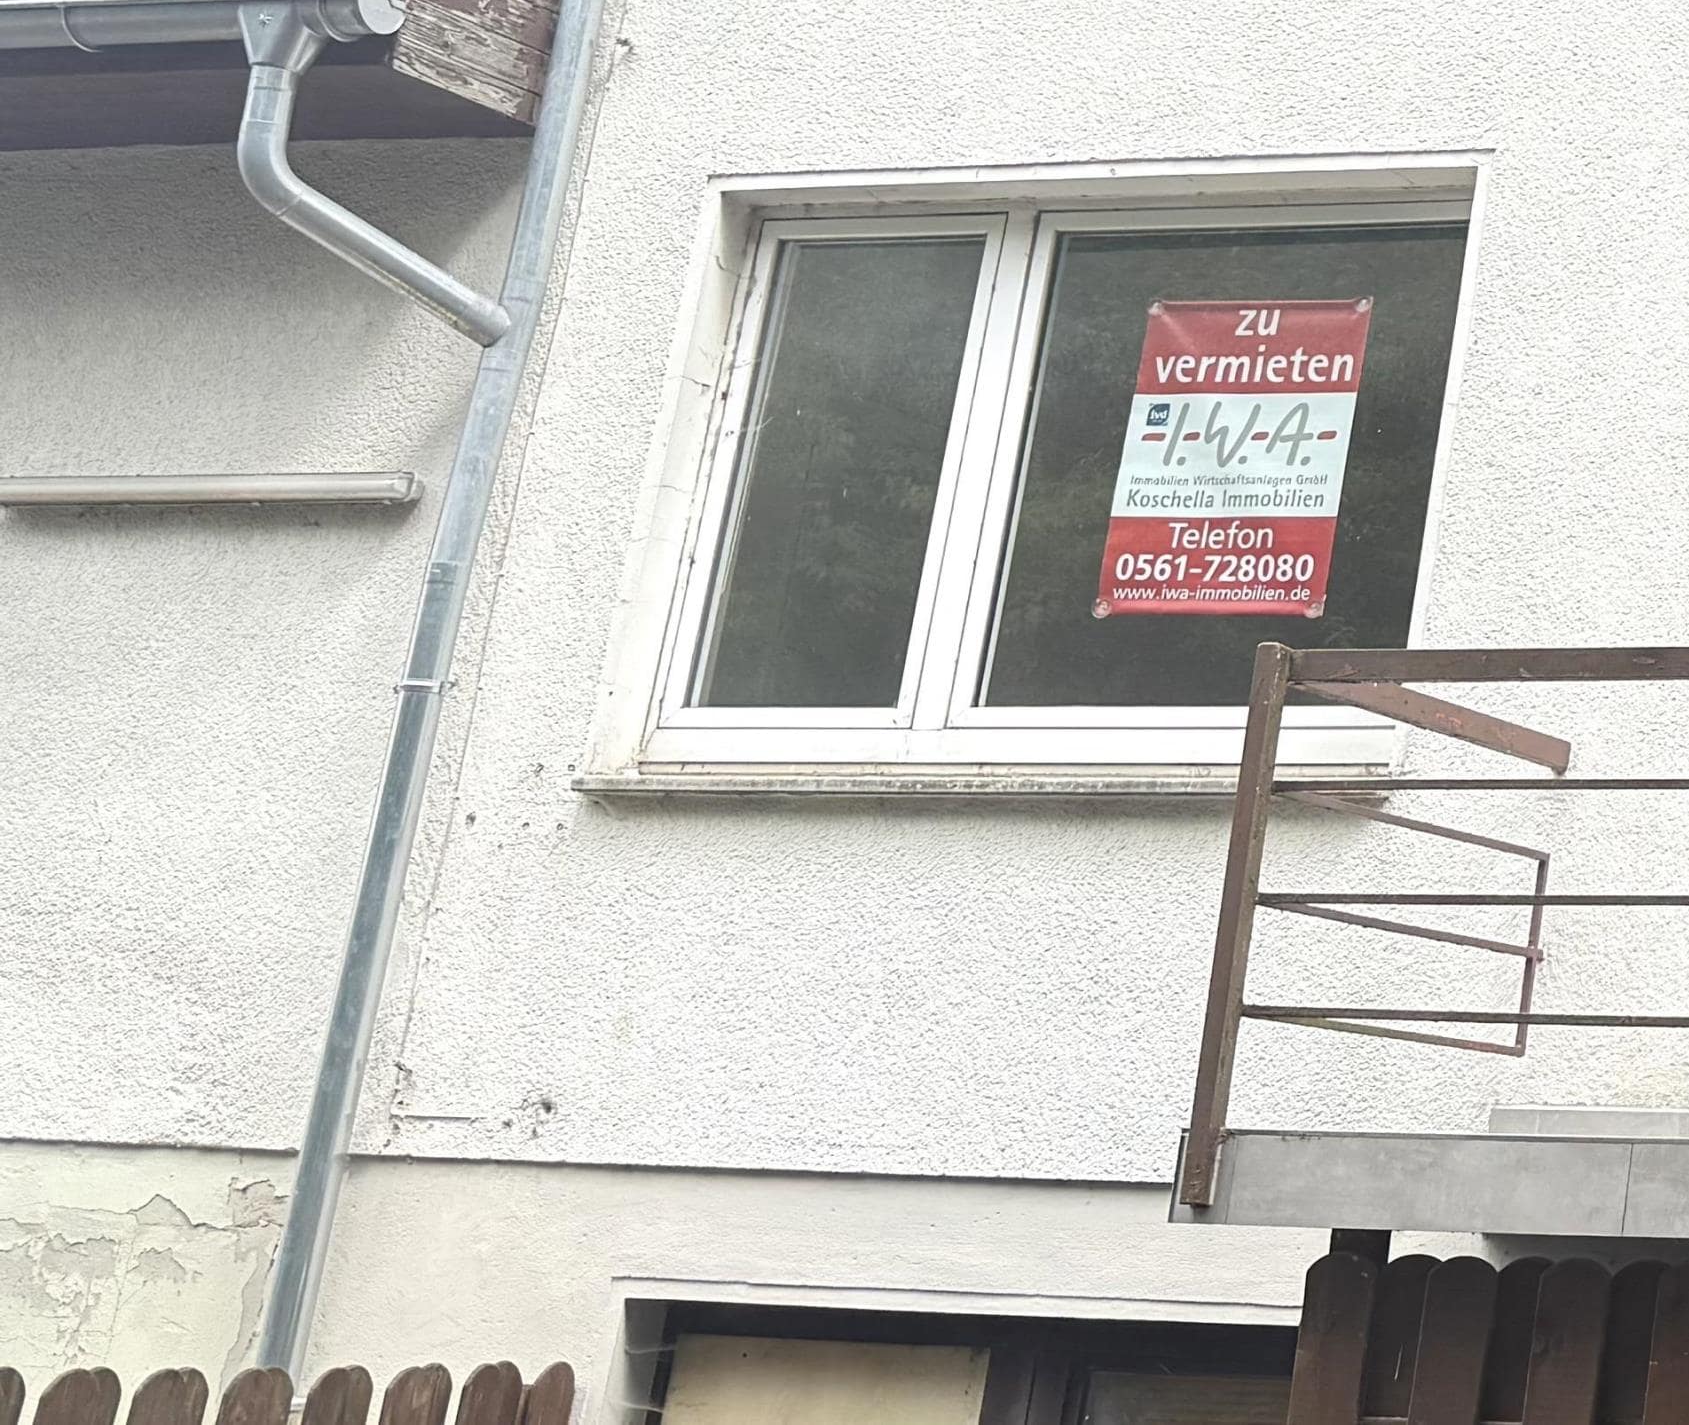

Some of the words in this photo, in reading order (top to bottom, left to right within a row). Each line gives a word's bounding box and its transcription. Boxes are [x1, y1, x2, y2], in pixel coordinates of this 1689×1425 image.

[1234, 309, 1280, 336] zu
[1155, 344, 1354, 384] vermieten
[1130, 475, 1189, 486] Immobilien
[1193, 474, 1292, 488] Wirtschaftsanlagen
[1296, 474, 1329, 486] GmbH
[1126, 488, 1215, 508] Koschella
[1221, 489, 1325, 508] Immobilien
[1168, 520, 1273, 550] Telefon
[1115, 553, 1315, 582] 0561-728080
[1113, 584, 1311, 602] www.iwa-immobilien.de
